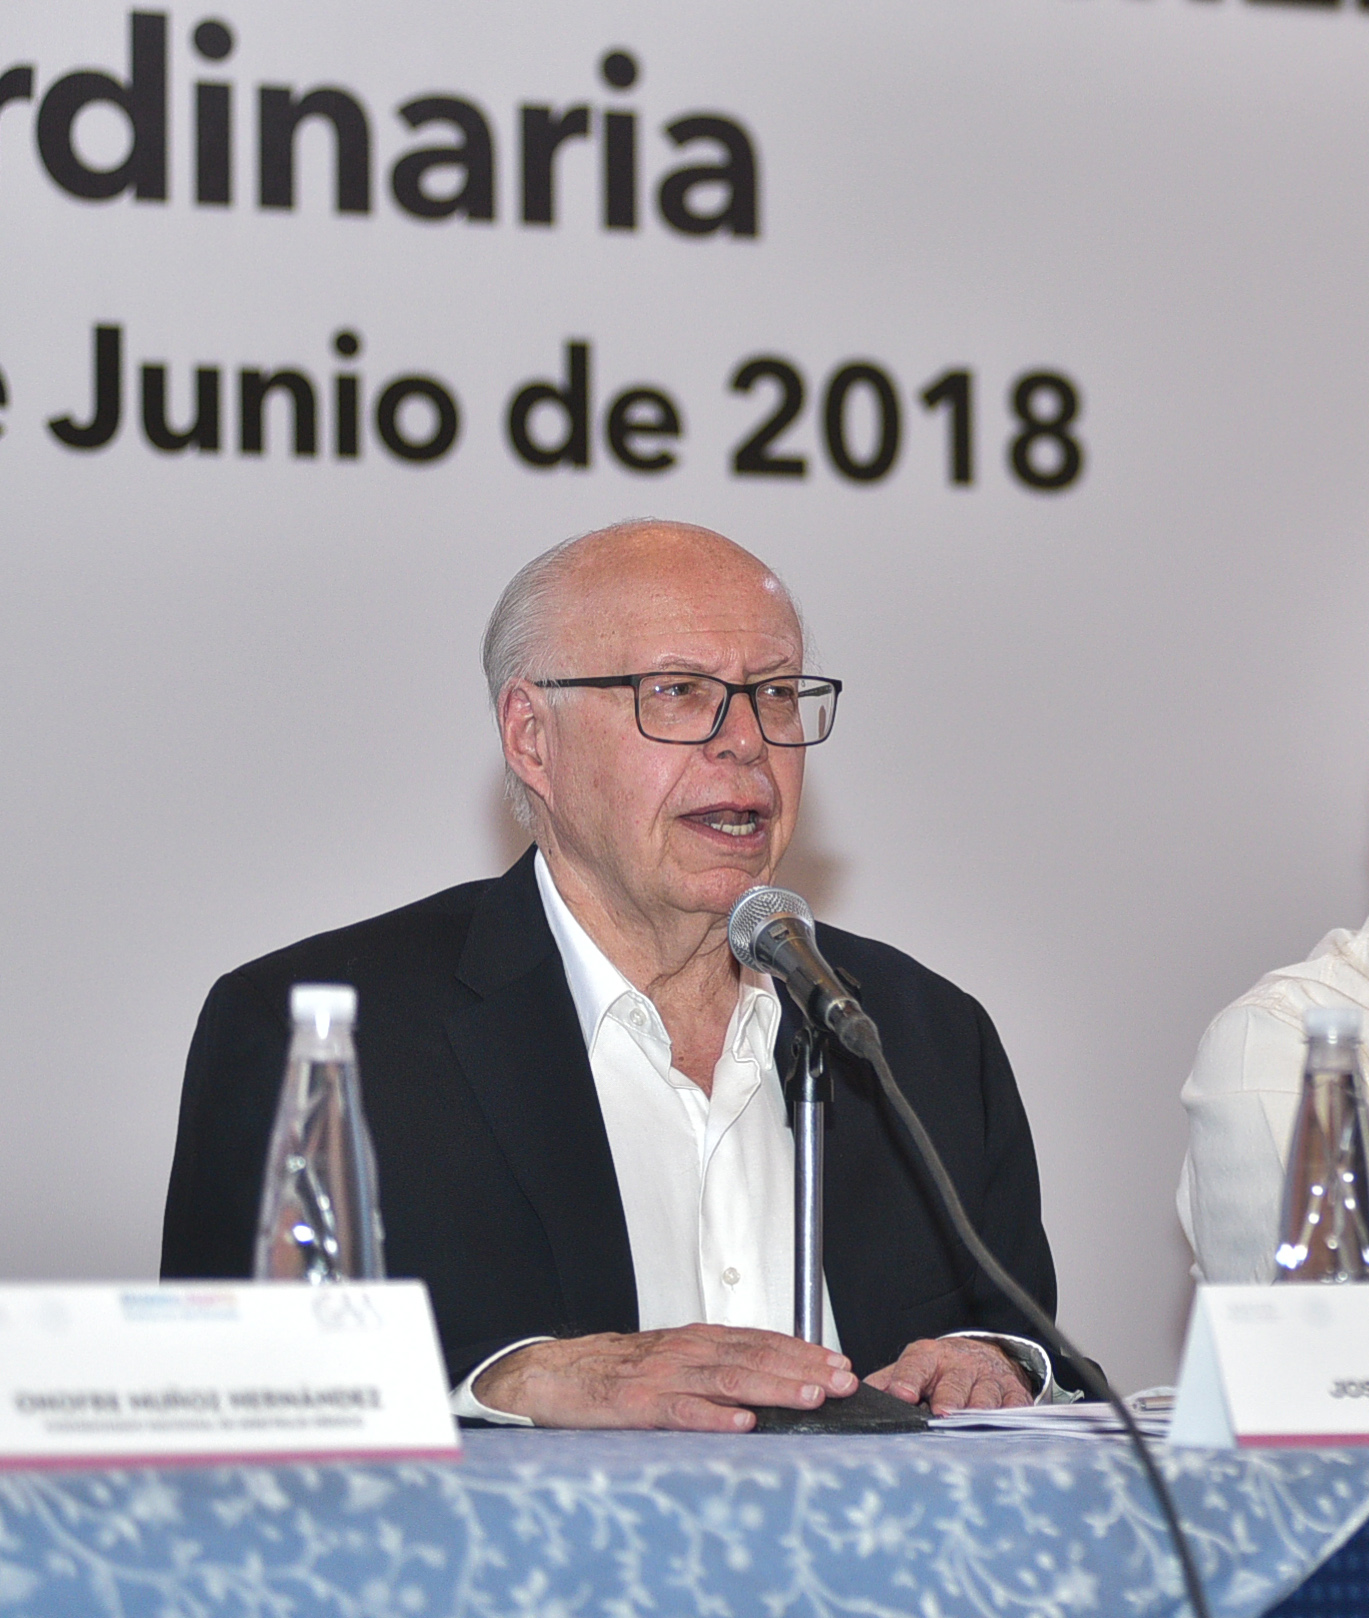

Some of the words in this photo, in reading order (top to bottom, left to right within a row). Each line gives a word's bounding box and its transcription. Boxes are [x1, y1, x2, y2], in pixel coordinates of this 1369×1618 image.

[46, 322, 462, 466] Junio
[506, 340, 683, 474] de
[727, 356, 1086, 493] 2018
